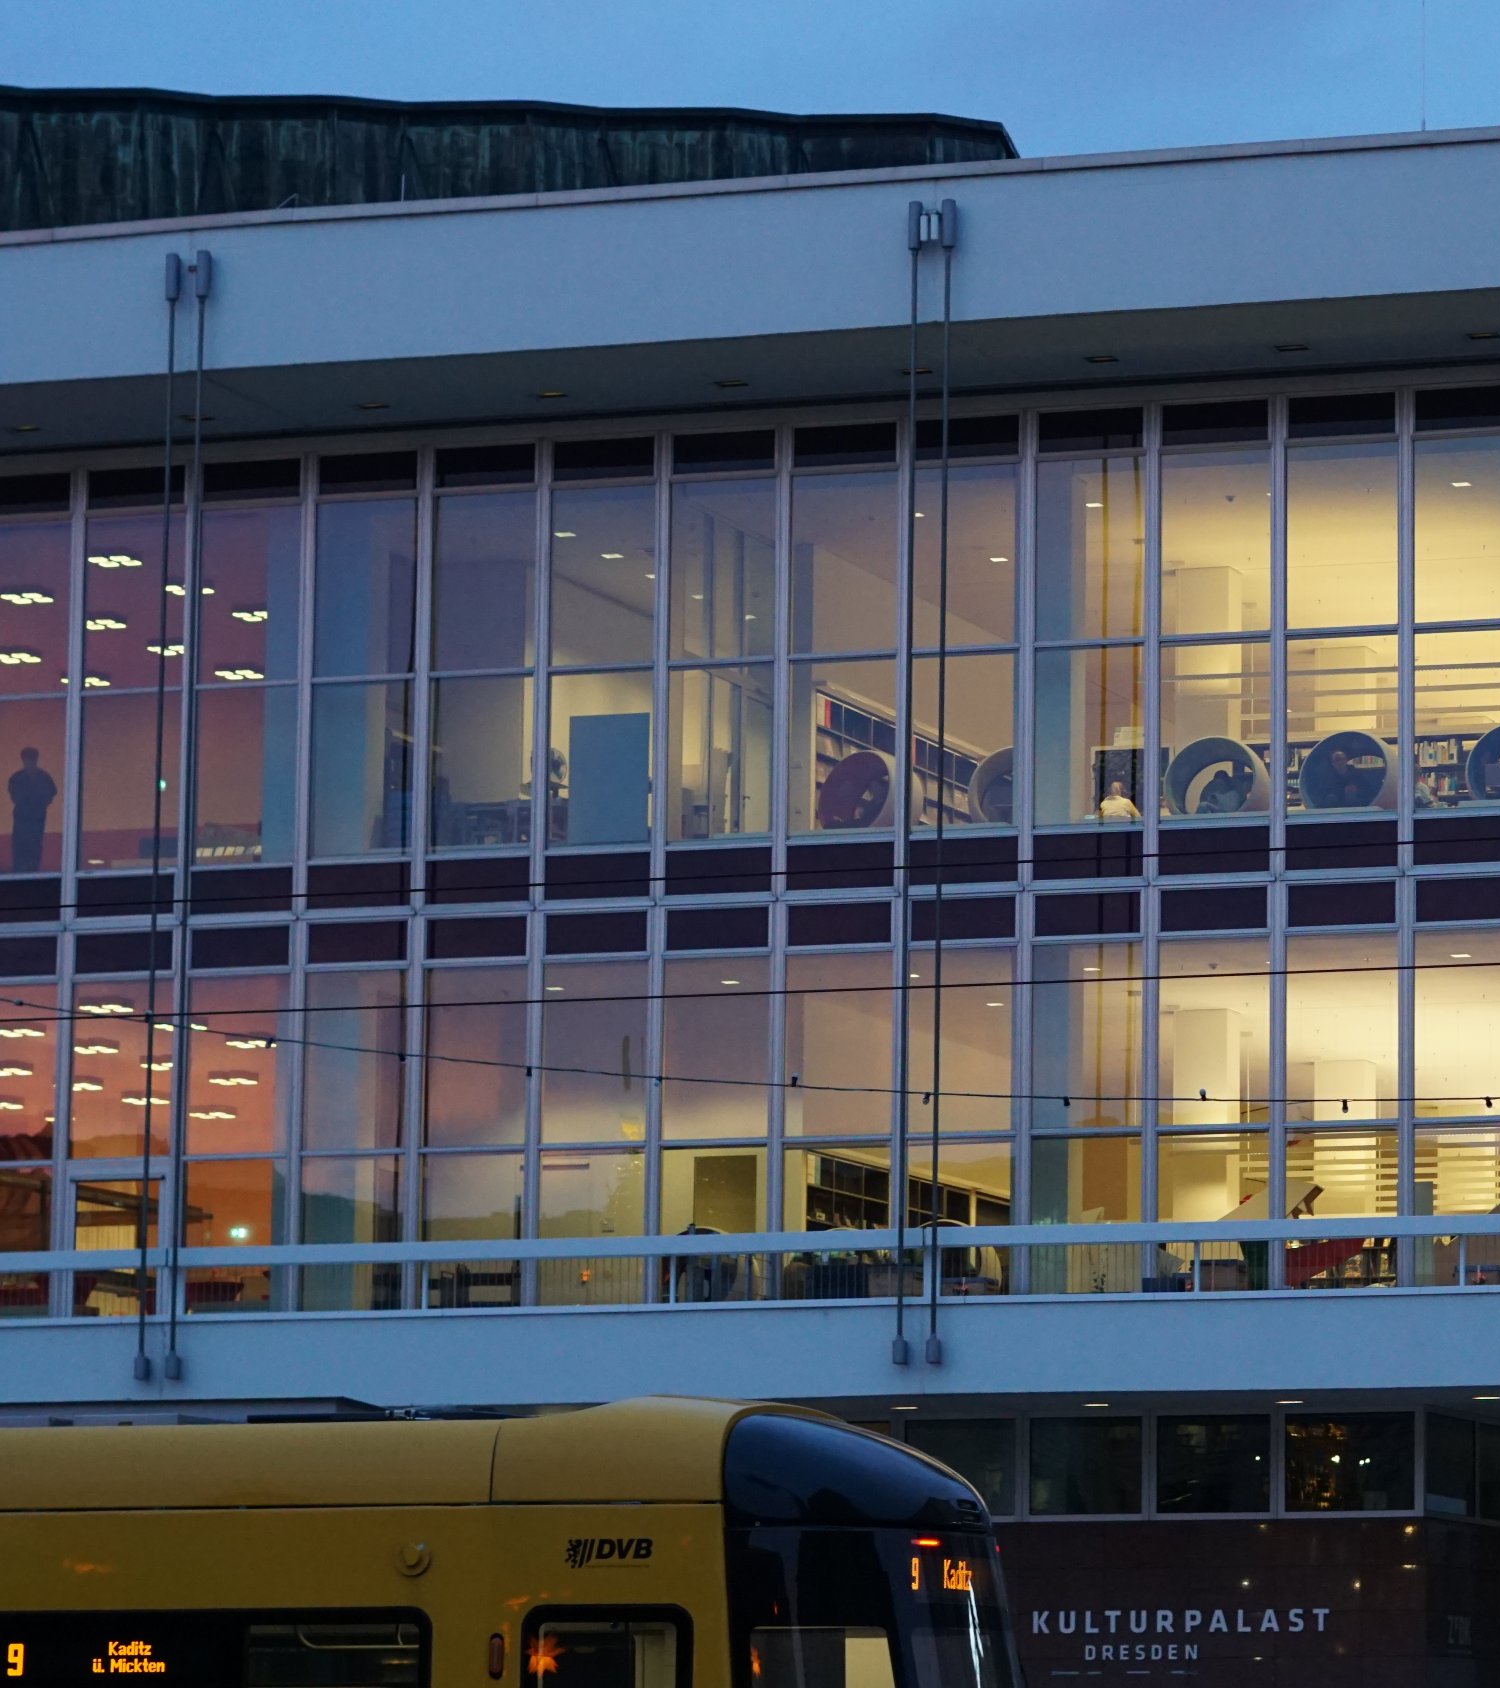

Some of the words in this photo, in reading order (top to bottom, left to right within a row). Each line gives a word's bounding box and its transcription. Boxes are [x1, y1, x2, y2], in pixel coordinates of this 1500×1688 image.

[595, 1538, 653, 1559] DVB
[911, 1556, 920, 1591] 9
[944, 1558, 972, 1591] Kaditz
[1033, 1609, 1329, 1634] KULTURPALAST
[108, 1641, 151, 1656] Kaditz
[1086, 1645, 1198, 1661] DRESDEN
[7, 1643, 24, 1676] 9
[92, 1658, 105, 1673] ü.
[110, 1658, 165, 1673] Mickten
